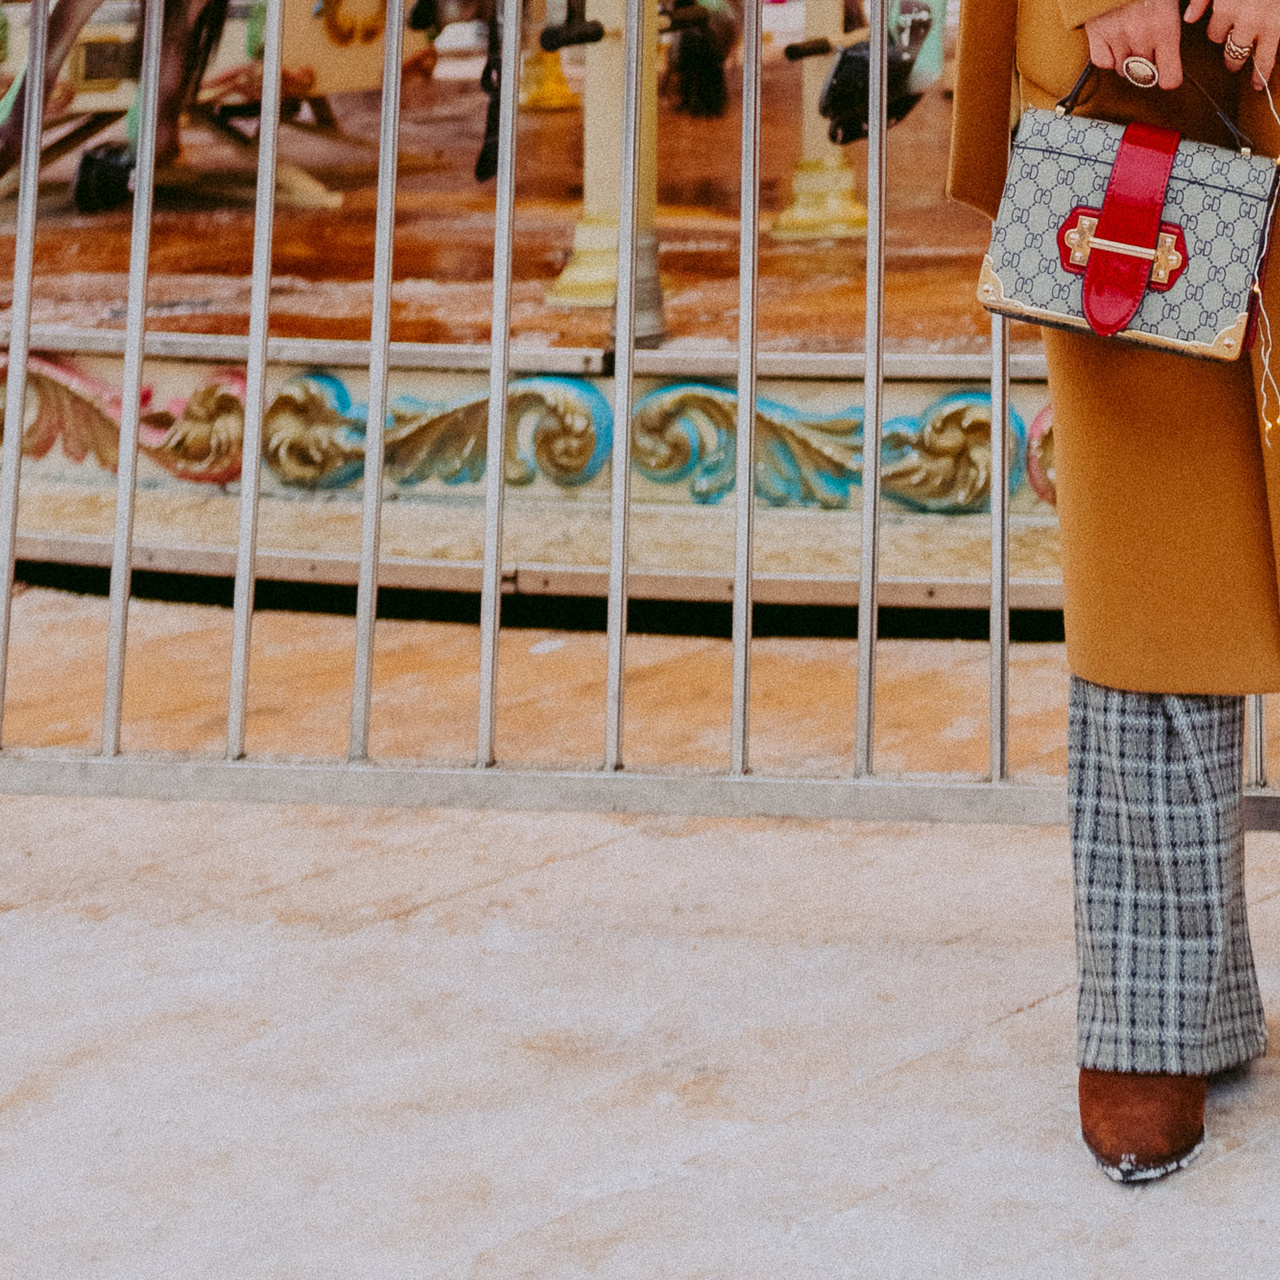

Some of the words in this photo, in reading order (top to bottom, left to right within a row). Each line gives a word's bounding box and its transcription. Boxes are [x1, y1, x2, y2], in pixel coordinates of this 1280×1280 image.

[1031, 121, 1050, 137] GD
[1067, 128, 1086, 144] GD
[1175, 152, 1193, 168] GD
[1211, 160, 1230, 176] GD
[1020, 163, 1039, 180] GD
[1057, 169, 1075, 186] GD
[1248, 168, 1267, 184] GD
[1166, 188, 1184, 205] GD
[1202, 195, 1221, 212] GD
[1011, 207, 1030, 224] GD
[1239, 202, 1257, 219] GD
[1194, 239, 1212, 256] GD
[1231, 246, 1249, 264] GD
[1002, 251, 1020, 268] GD
[1038, 257, 1057, 274] GD
[1185, 284, 1204, 301] GD
[1222, 291, 1241, 309] GD
